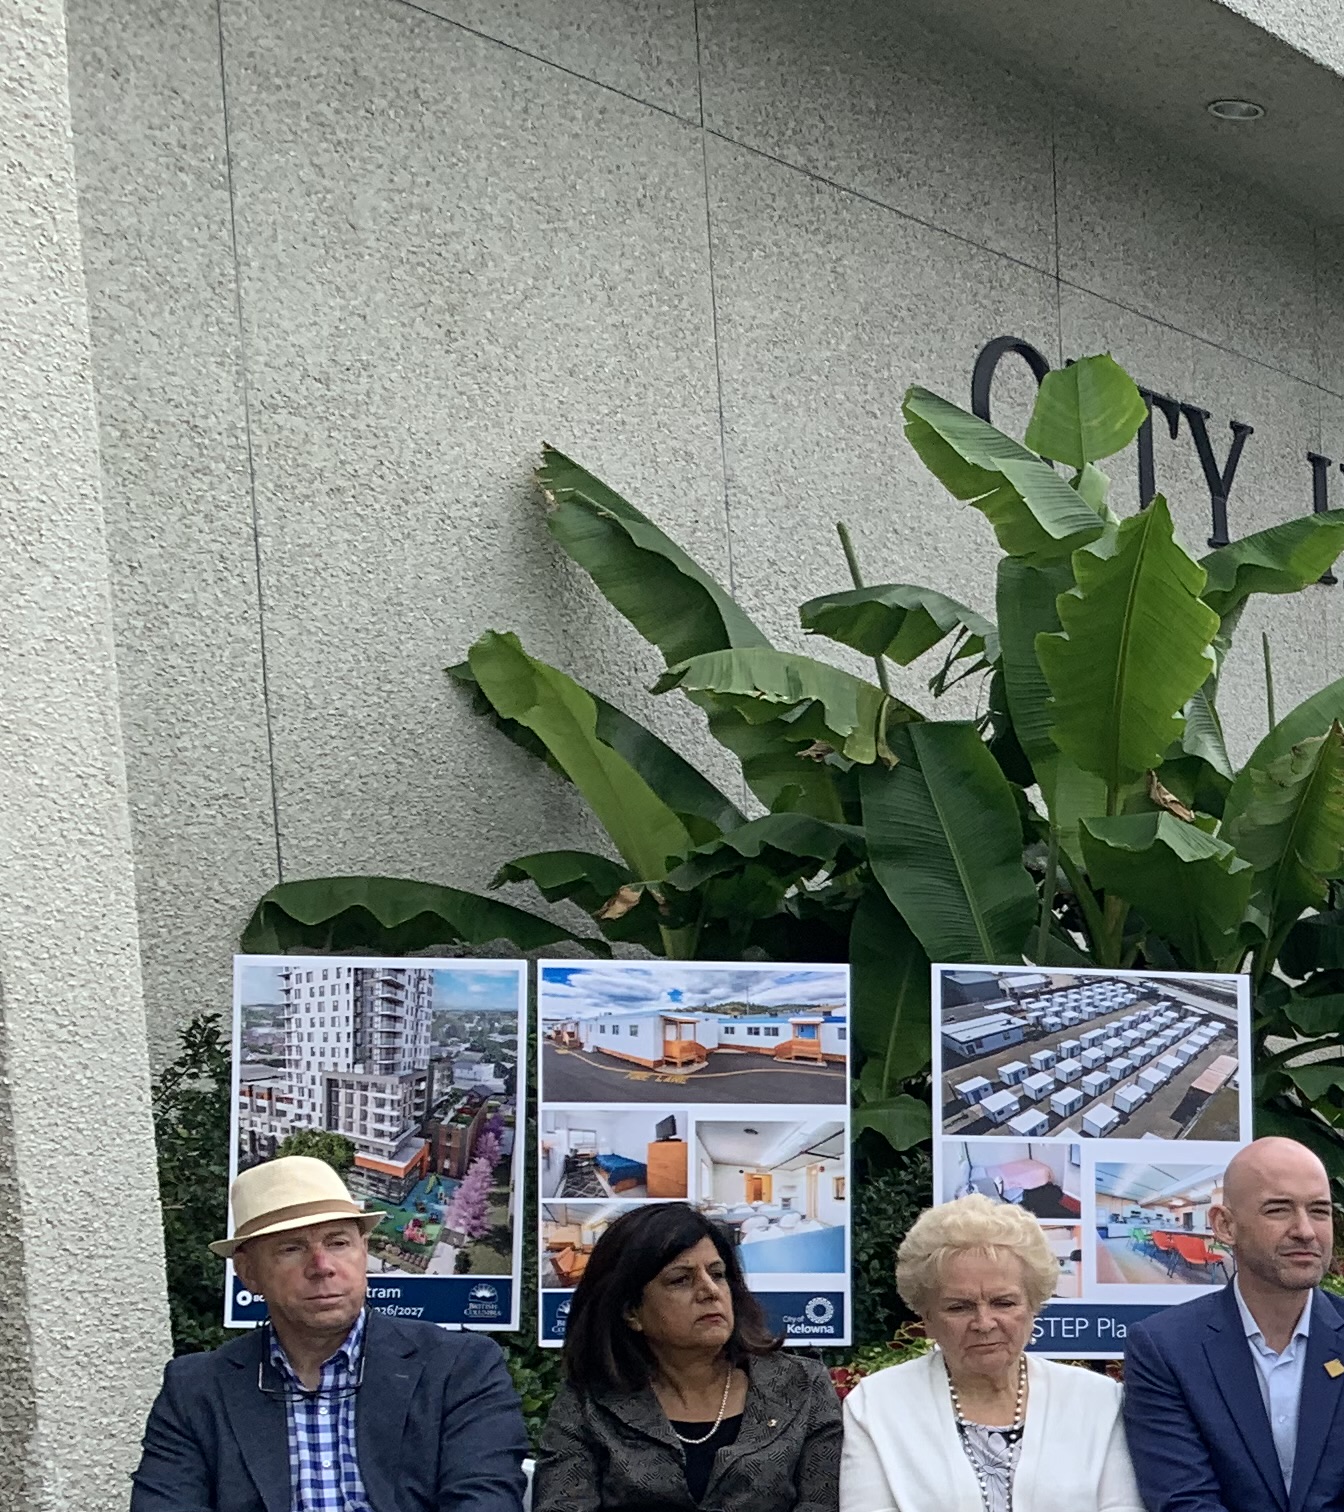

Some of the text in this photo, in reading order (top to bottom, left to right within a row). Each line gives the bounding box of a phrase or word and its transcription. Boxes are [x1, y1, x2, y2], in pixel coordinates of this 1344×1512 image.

[971, 336, 1254, 548] CTY
[366, 1286, 401, 1299] tram
[374, 1304, 425, 1318] 26/2027
[787, 1323, 835, 1334] Kelowna
[1031, 1317, 1127, 1338] STEP Pla
